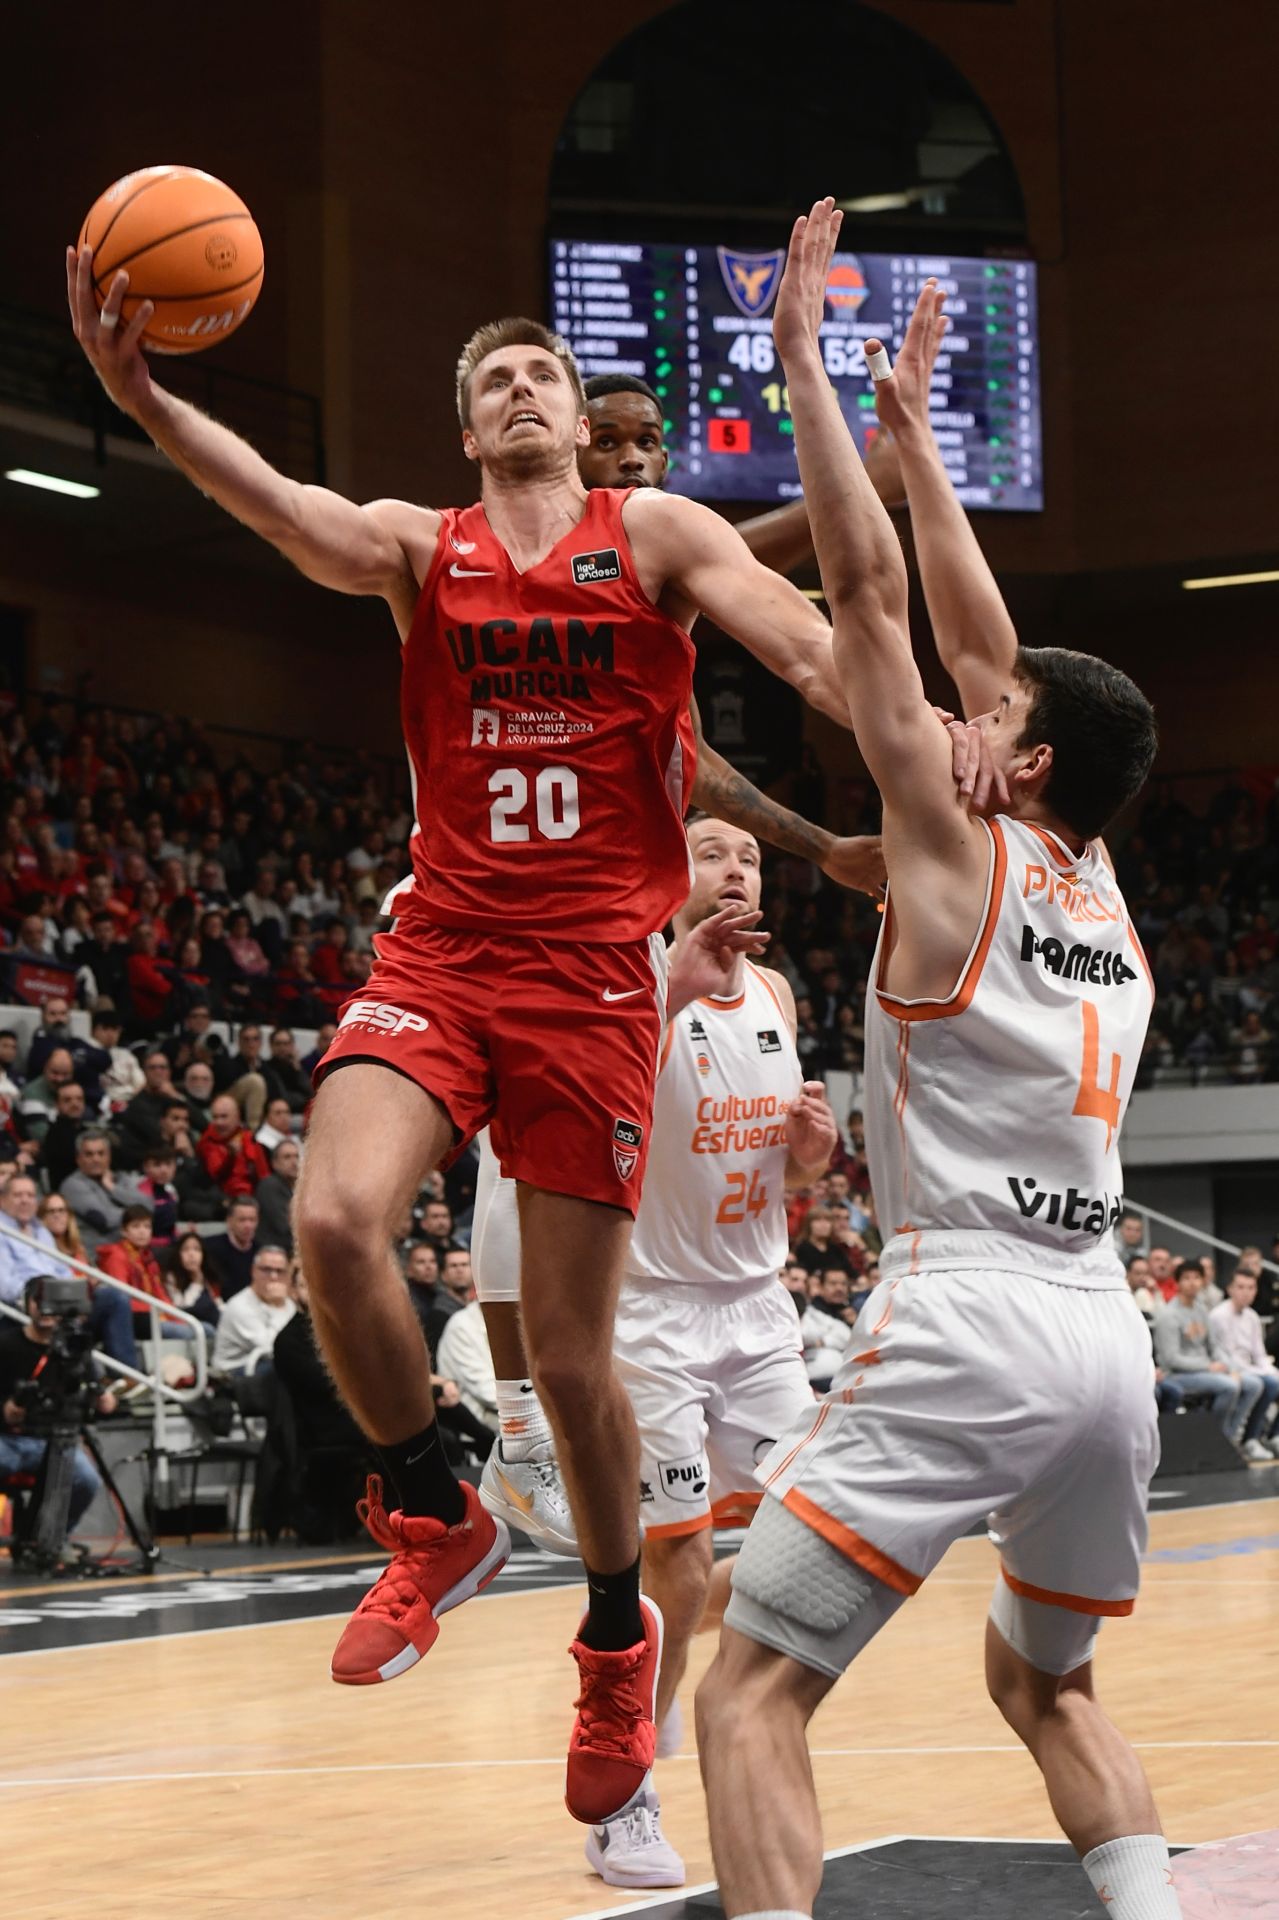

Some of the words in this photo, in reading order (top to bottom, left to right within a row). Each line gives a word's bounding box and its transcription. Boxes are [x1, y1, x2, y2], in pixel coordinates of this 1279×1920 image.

[728, 333, 775, 373] 46
[824, 338, 868, 377] 52
[722, 424, 737, 447] 5
[577, 563, 595, 573] liga
[578, 567, 618, 581] endesa
[445, 617, 614, 674] UCAM
[470, 670, 593, 704] MURCIA
[507, 711, 566, 722] CARAVACA
[507, 723, 521, 734] DE
[522, 724, 535, 734] LA
[536, 723, 565, 734] CRUZ
[566, 723, 594, 733] 2024
[505, 734, 528, 745] AÑO
[528, 735, 571, 745] JUBILAR
[488, 766, 581, 843] 20
[1072, 1000, 1122, 1155] 4
[696, 1095, 777, 1124] Cultura
[616, 1129, 635, 1143] acb
[716, 1169, 769, 1224] 24
